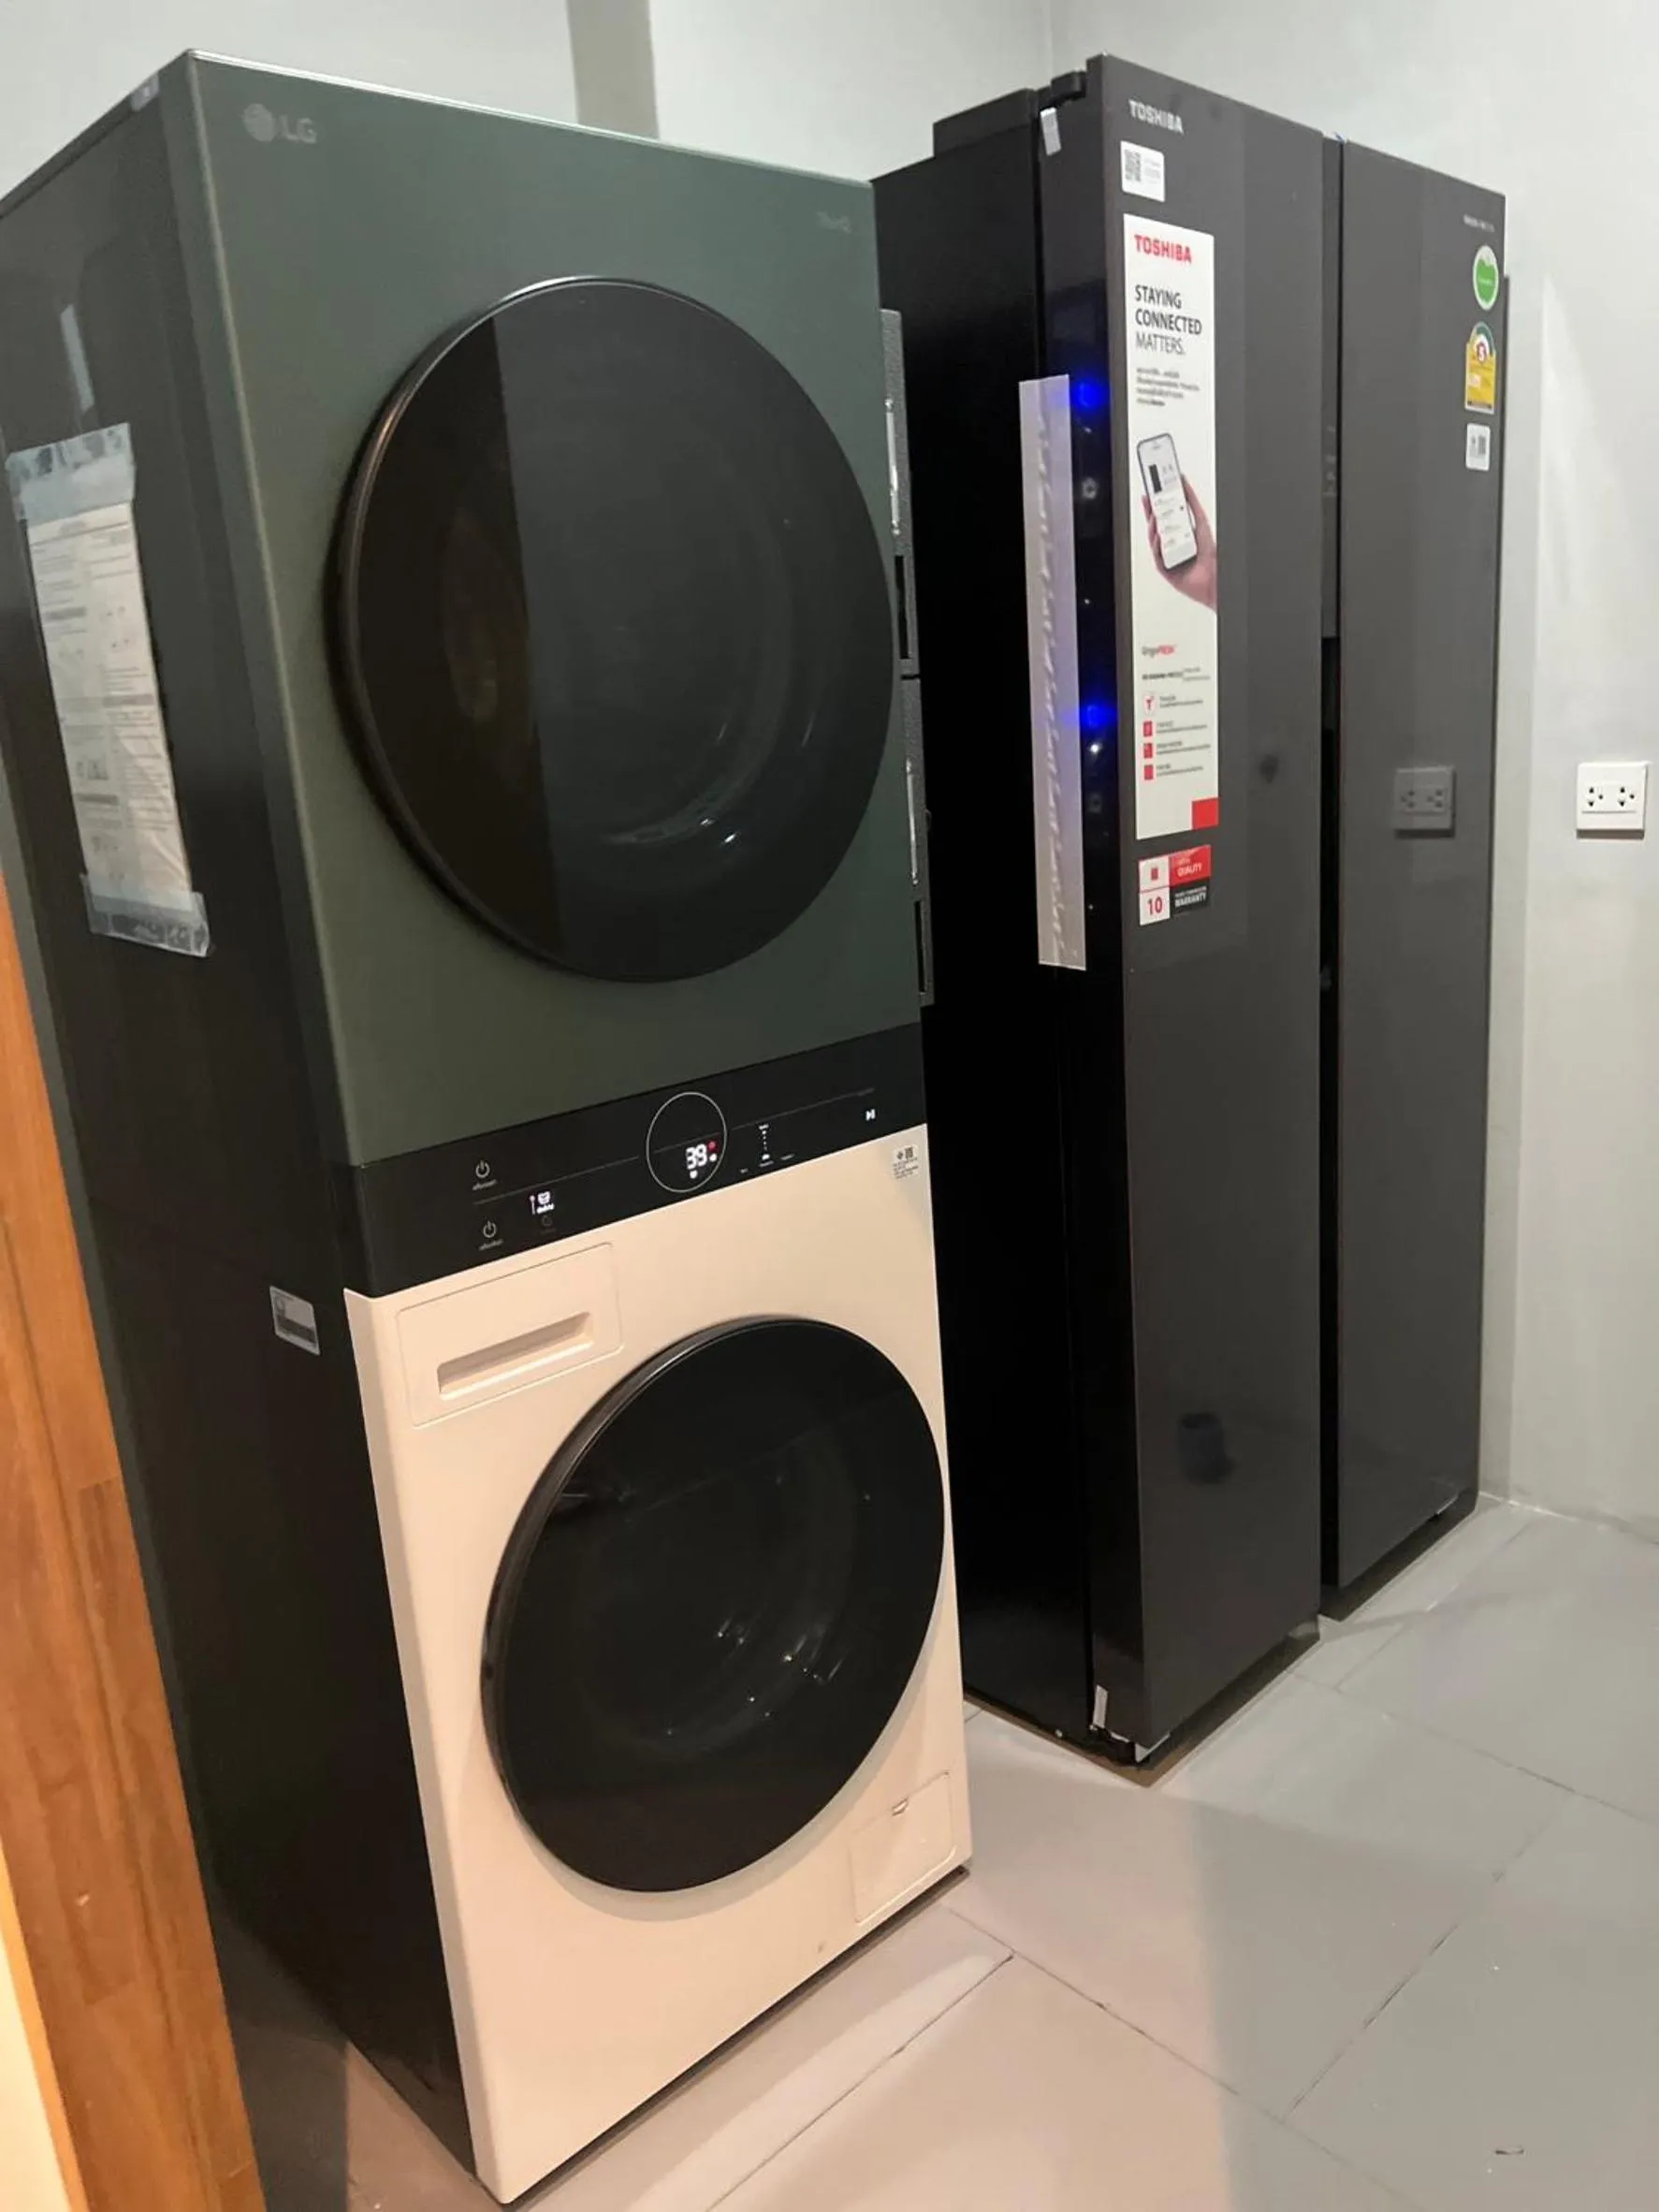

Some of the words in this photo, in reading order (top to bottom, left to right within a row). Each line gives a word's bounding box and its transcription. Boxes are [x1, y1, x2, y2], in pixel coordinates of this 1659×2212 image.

[280, 113, 317, 144] LG
[1128, 98, 1185, 135] TOSHIBA
[1134, 234, 1192, 264] TOSHIBA
[1135, 284, 1183, 310] STAYING
[1135, 308, 1203, 336] CONNECTED
[1147, 895, 1163, 916] 10
[685, 1142, 708, 1171] 39
